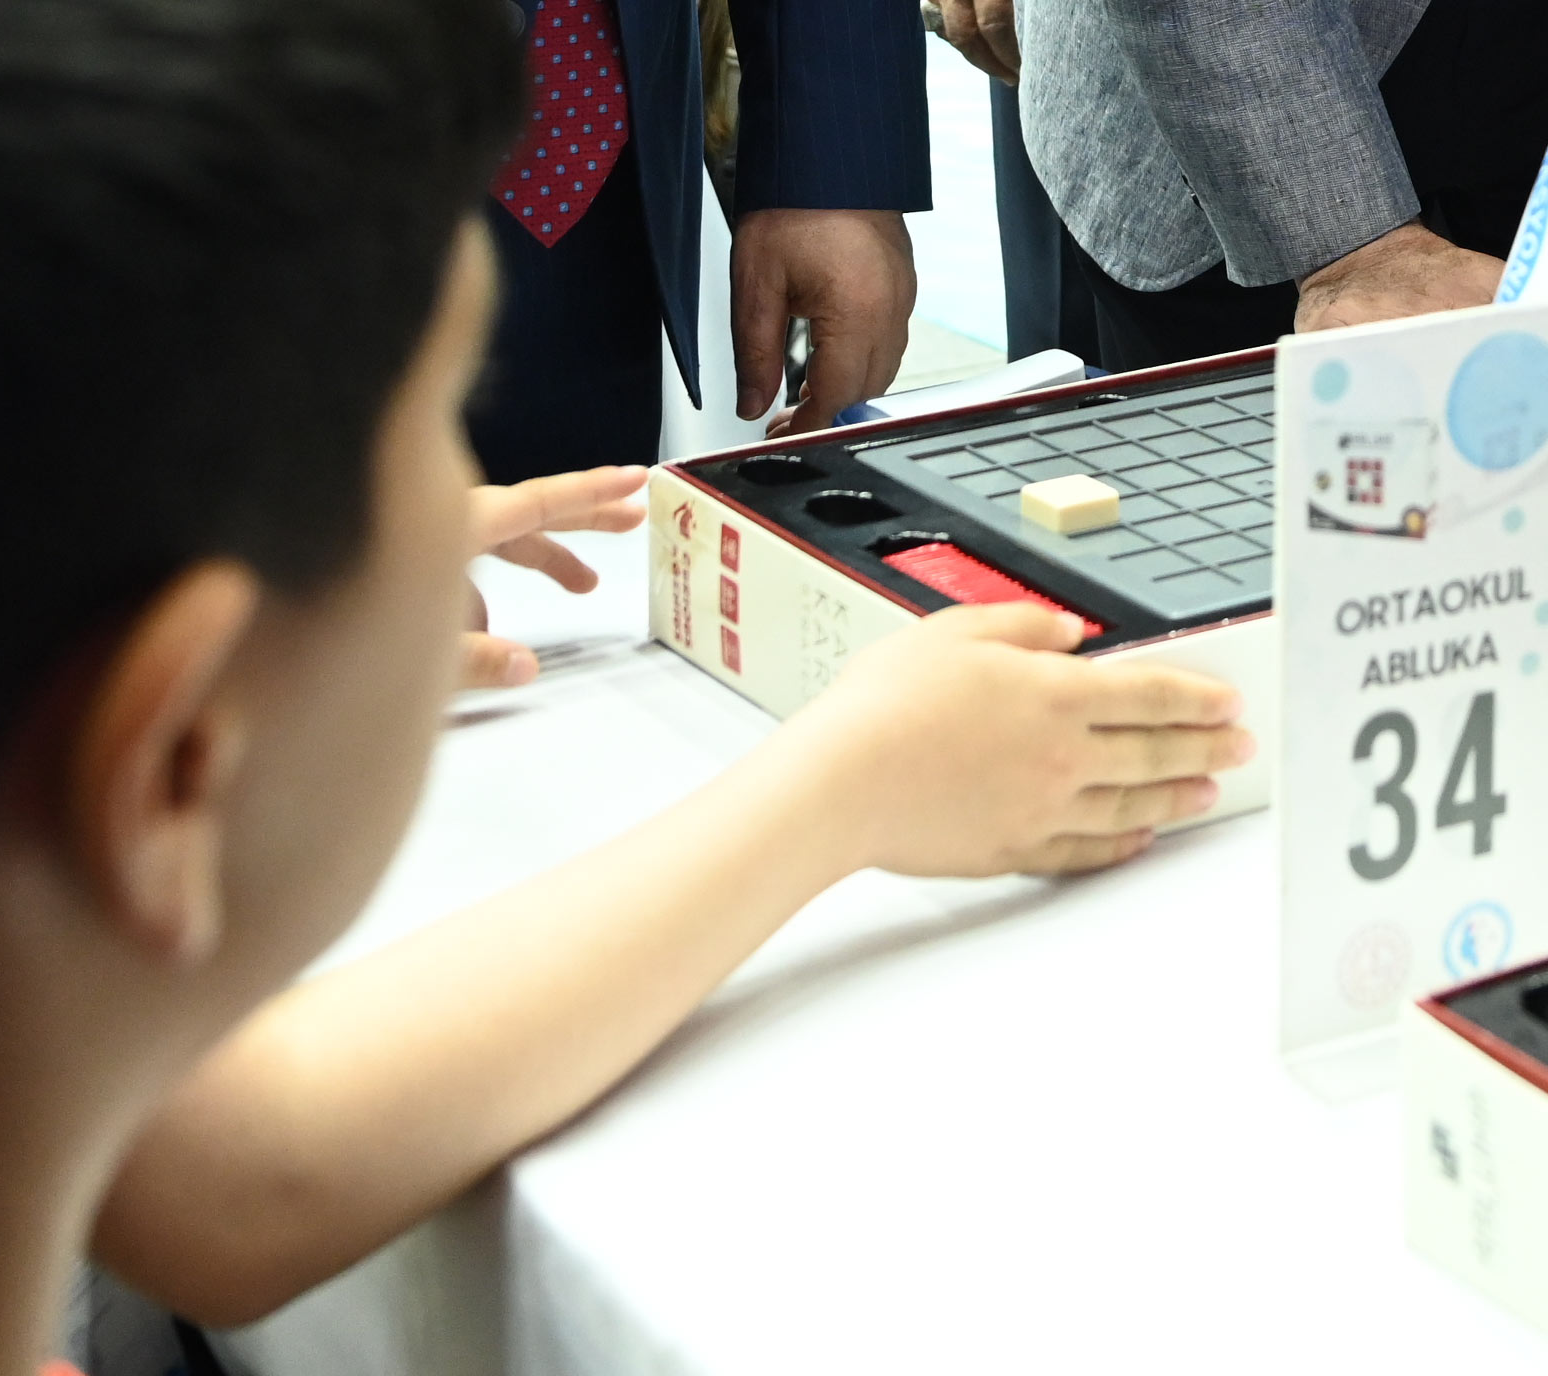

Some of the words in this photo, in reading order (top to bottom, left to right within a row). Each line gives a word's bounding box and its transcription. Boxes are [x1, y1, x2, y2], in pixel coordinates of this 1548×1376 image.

[1335, 566, 1533, 637] ORTAOKUL
[1361, 632, 1499, 692] ABLUKA
[1348, 690, 1508, 885] 34
